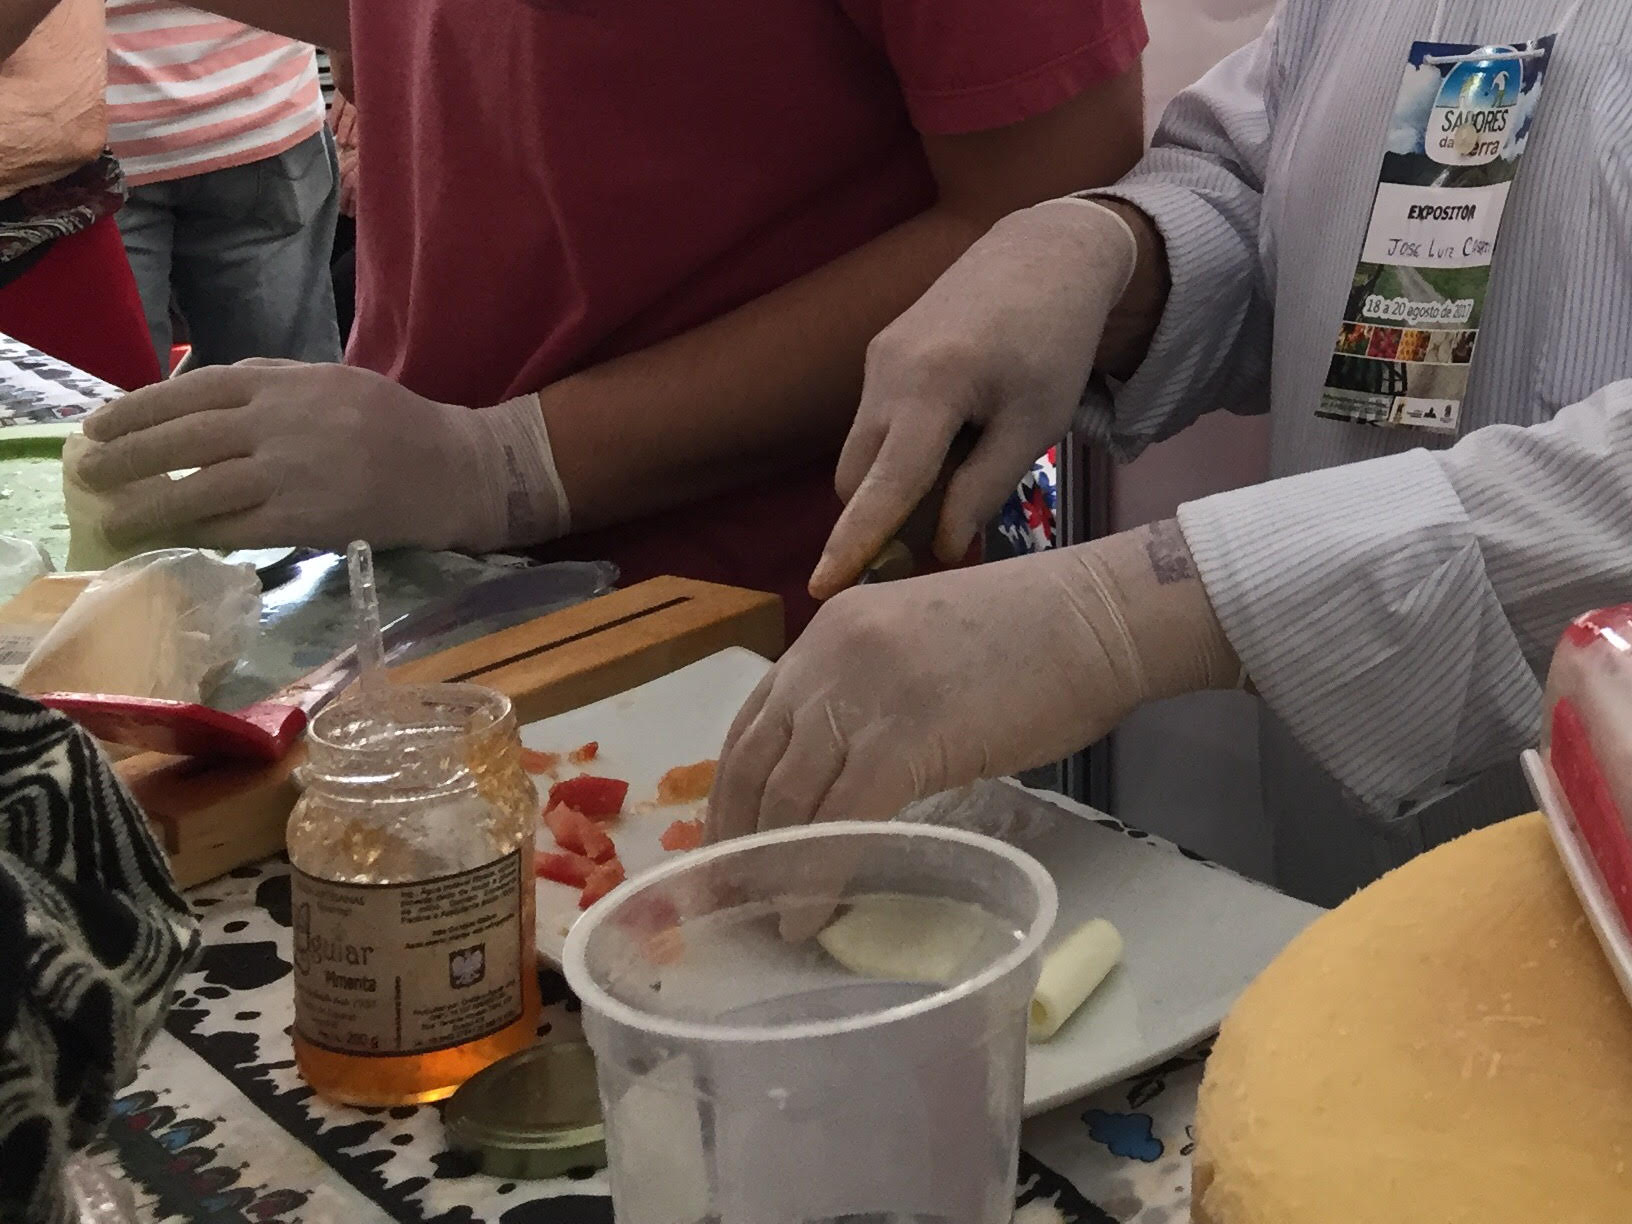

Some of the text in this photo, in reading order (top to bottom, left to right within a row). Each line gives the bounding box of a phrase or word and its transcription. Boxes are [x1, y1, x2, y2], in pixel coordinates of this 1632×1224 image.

[1407, 204, 1477, 222] EXPOSITOR
[1366, 299, 1381, 314] 18
[1382, 304, 1389, 314] a
[1391, 301, 1406, 316] 20
[1406, 303, 1438, 321] agosto
[1440, 304, 1452, 318] de
